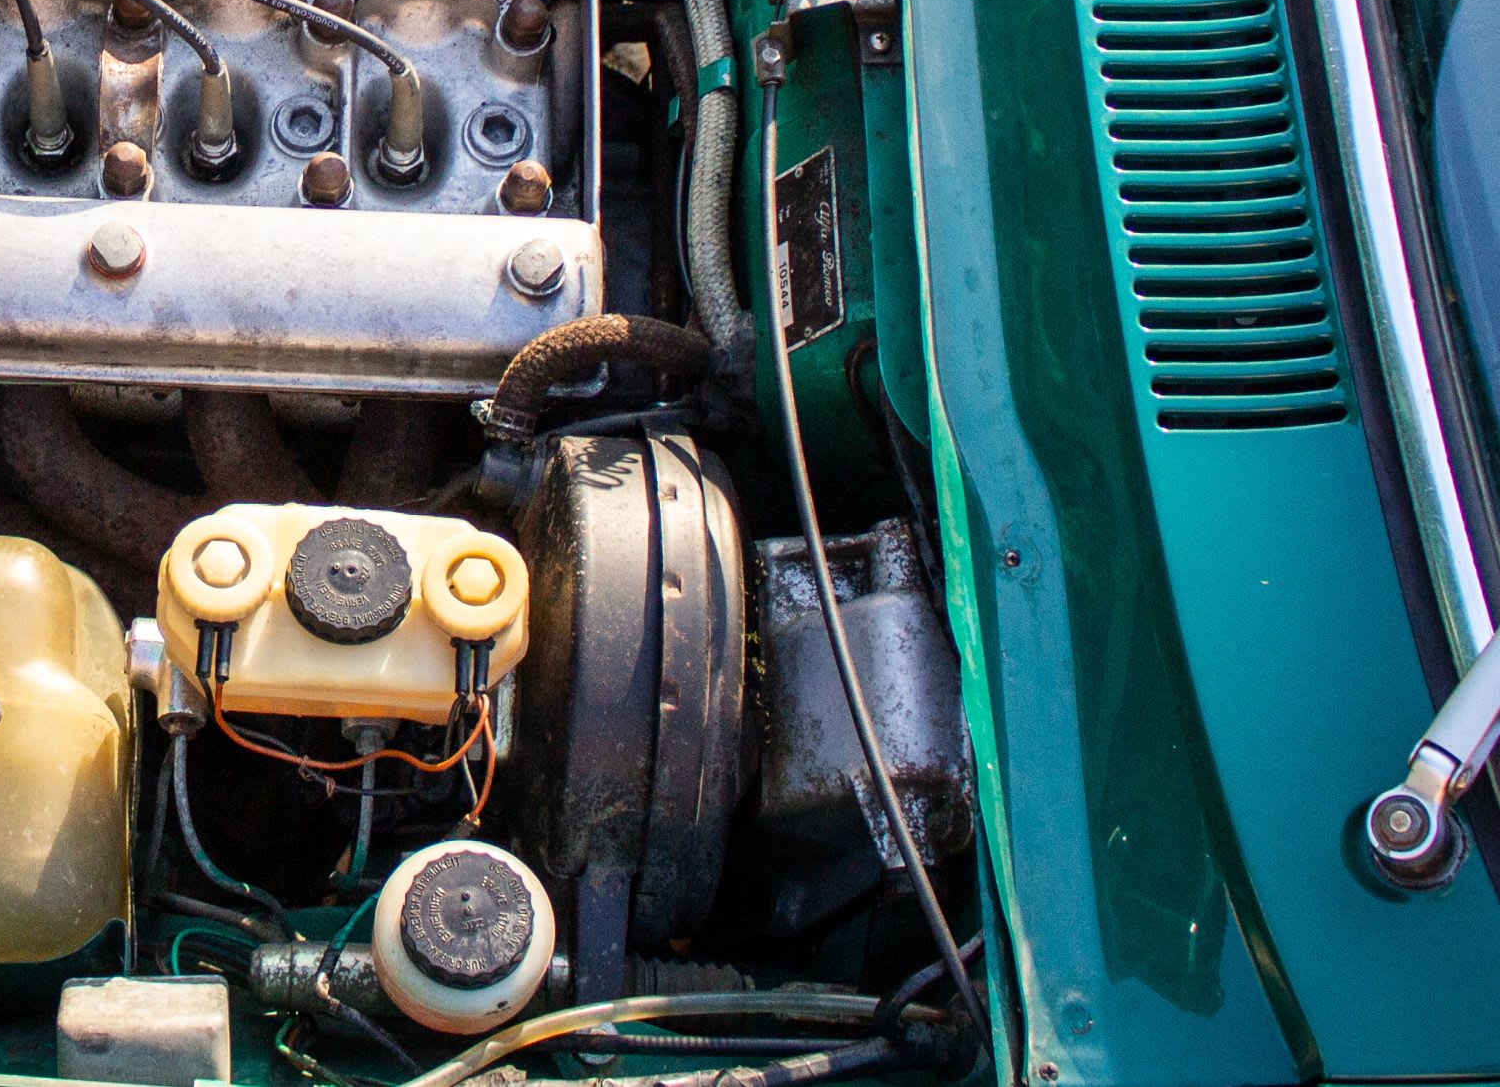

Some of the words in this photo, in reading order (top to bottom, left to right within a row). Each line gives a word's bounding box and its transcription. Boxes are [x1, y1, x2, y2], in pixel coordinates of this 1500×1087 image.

[272, 0, 288, 10] 403
[289, 5, 339, 31] BOUGICORD
[815, 201, 831, 243] Alfa
[778, 260, 790, 310] 10544
[822, 250, 835, 307] Romeo
[319, 523, 339, 538] USE
[343, 521, 368, 533] ONLY
[369, 527, 401, 561] ORIGINAL
[329, 538, 363, 552] BRAKE
[367, 545, 385, 568] FLUID
[489, 862, 509, 880] USE
[481, 875, 508, 907] BRAKE
[465, 957, 487, 970] NUR
